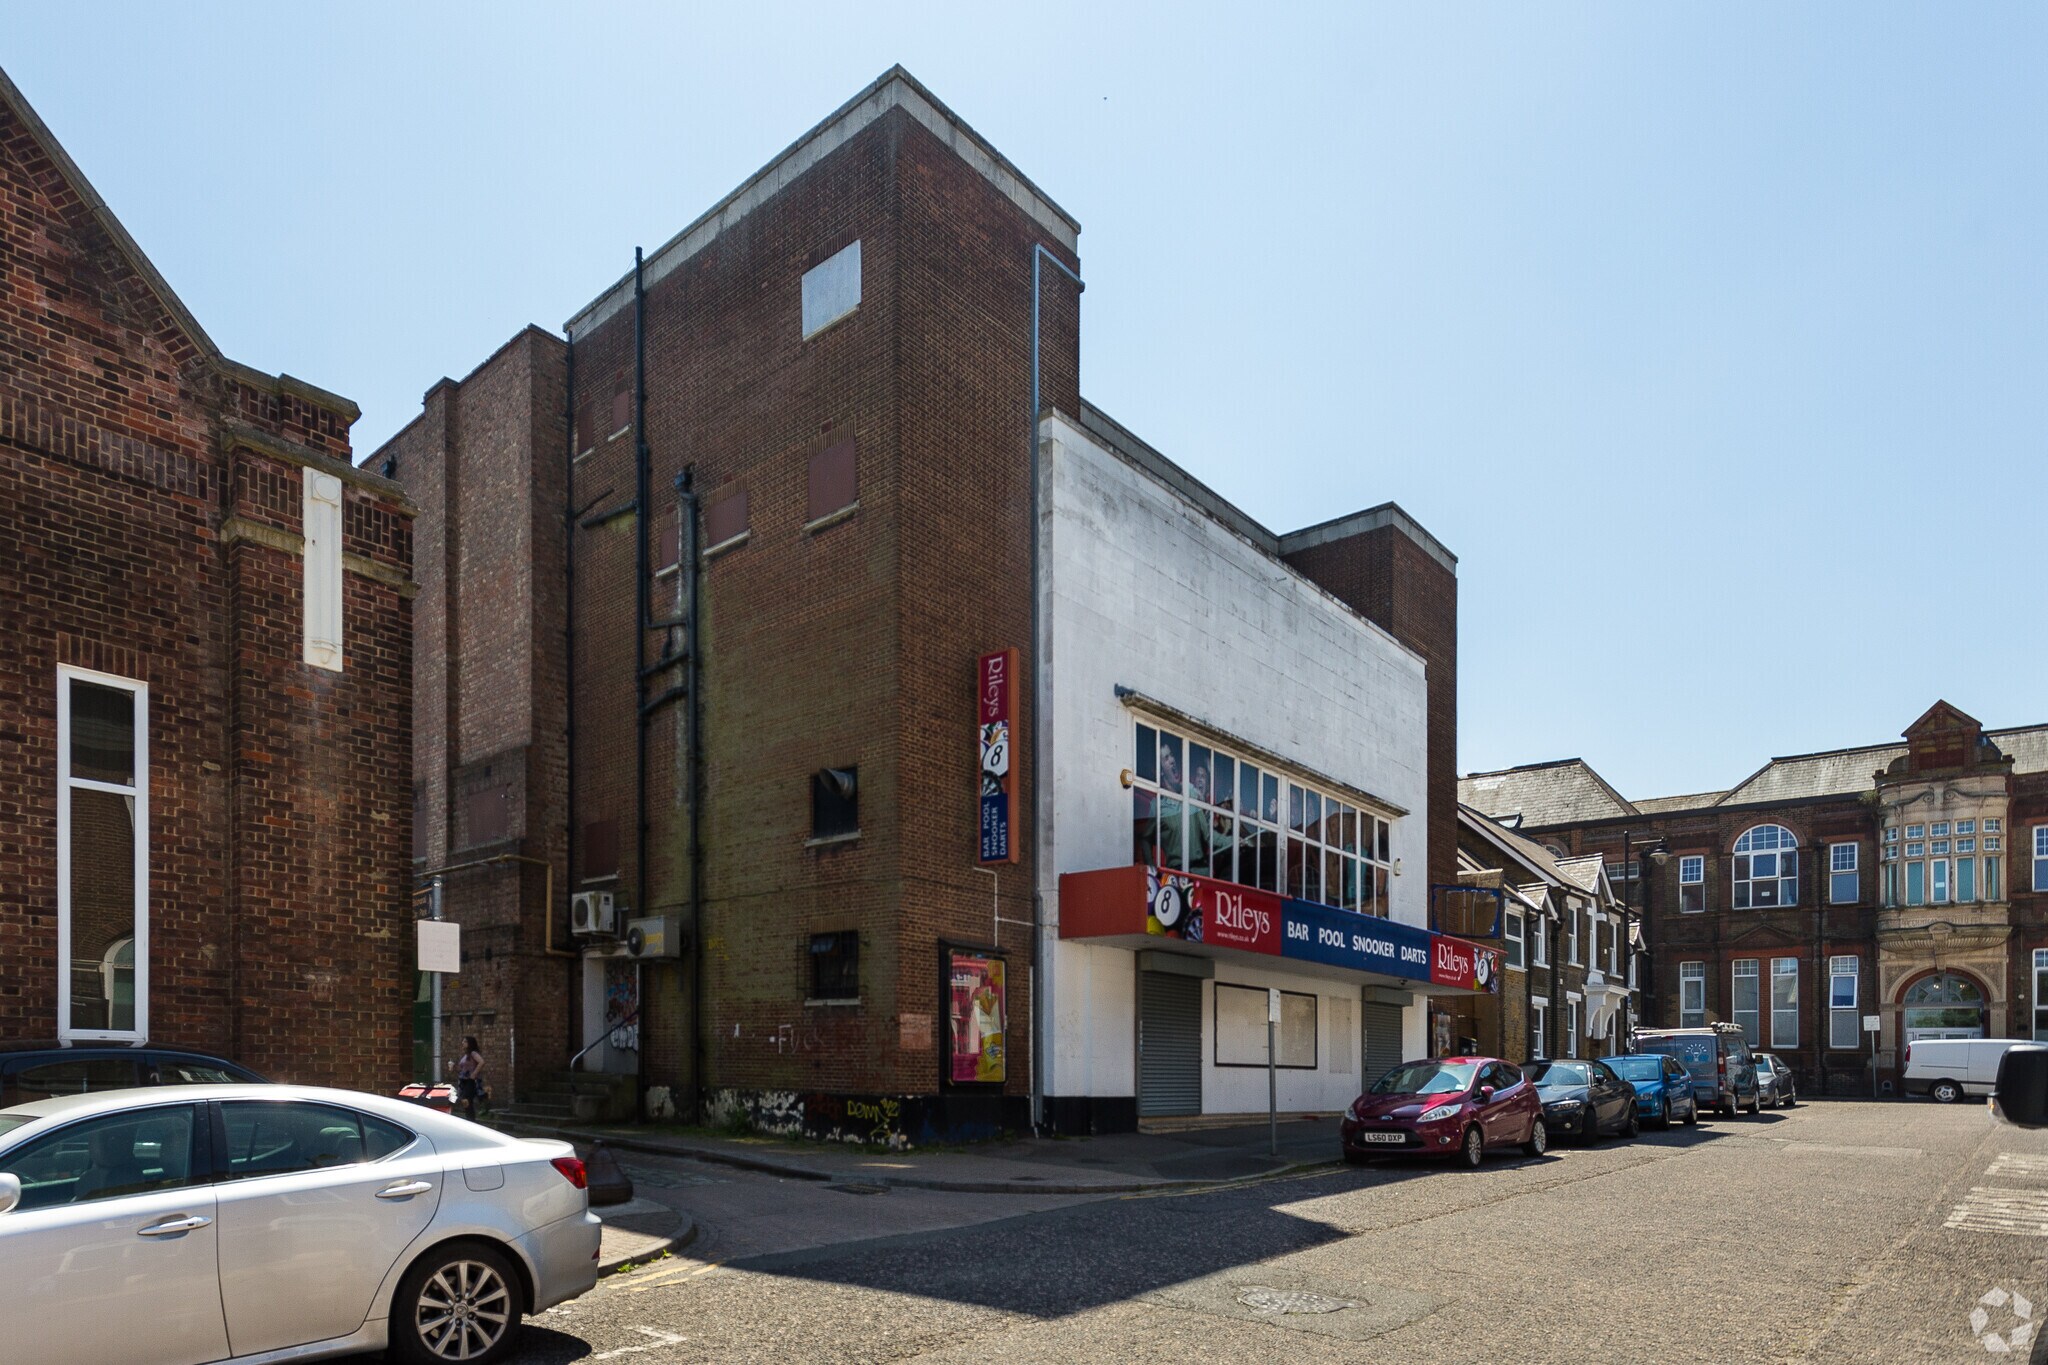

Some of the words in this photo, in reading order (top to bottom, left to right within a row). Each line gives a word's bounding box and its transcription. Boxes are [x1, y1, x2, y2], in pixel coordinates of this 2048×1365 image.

[984, 656, 1003, 717] Rileys
[982, 801, 990, 829] POOL
[991, 806, 999, 856] SNOOKER
[982, 837, 990, 857] BAR
[1160, 889, 1172, 914] 8
[1215, 890, 1271, 943] Rileys
[1287, 920, 1309, 941] BAR
[1319, 927, 1346, 948] POOL
[1352, 934, 1395, 958] SNOOKER
[1401, 945, 1427, 965] DARTS
[1438, 943, 1468, 981] Rileys
[1388, 1134, 1403, 1142] DXP
